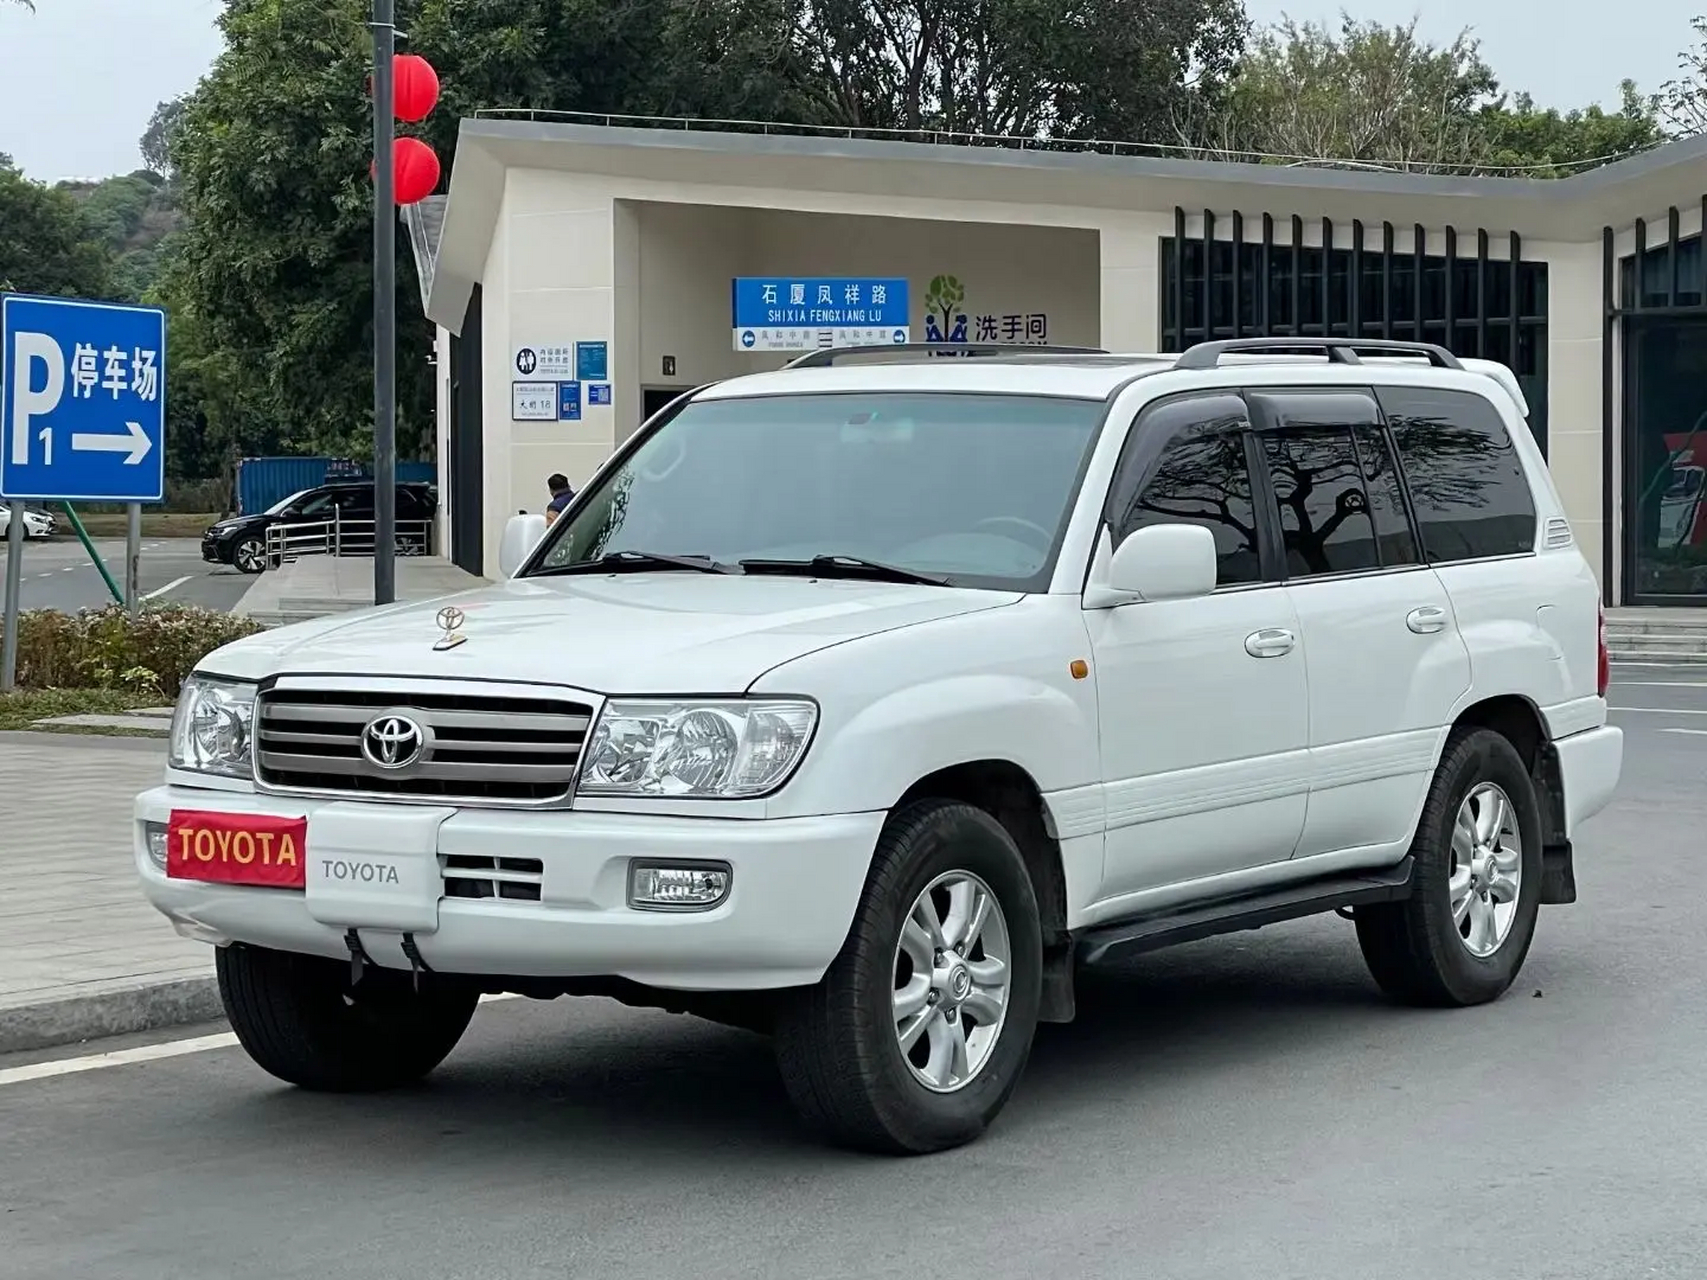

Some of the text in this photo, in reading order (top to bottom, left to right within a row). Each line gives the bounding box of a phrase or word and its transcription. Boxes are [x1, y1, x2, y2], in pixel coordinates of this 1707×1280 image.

[762, 284, 887, 305] 石厦凤祥路
[768, 309, 882, 322] SHIXIA FENGXIANG LU
[975, 314, 1047, 341] 洗手间
[71, 342, 157, 401] 停车场
[12, 331, 65, 464] P
[39, 427, 52, 465] 1
[178, 829, 297, 866] TOYOTA
[322, 860, 399, 884] TOYOTA
